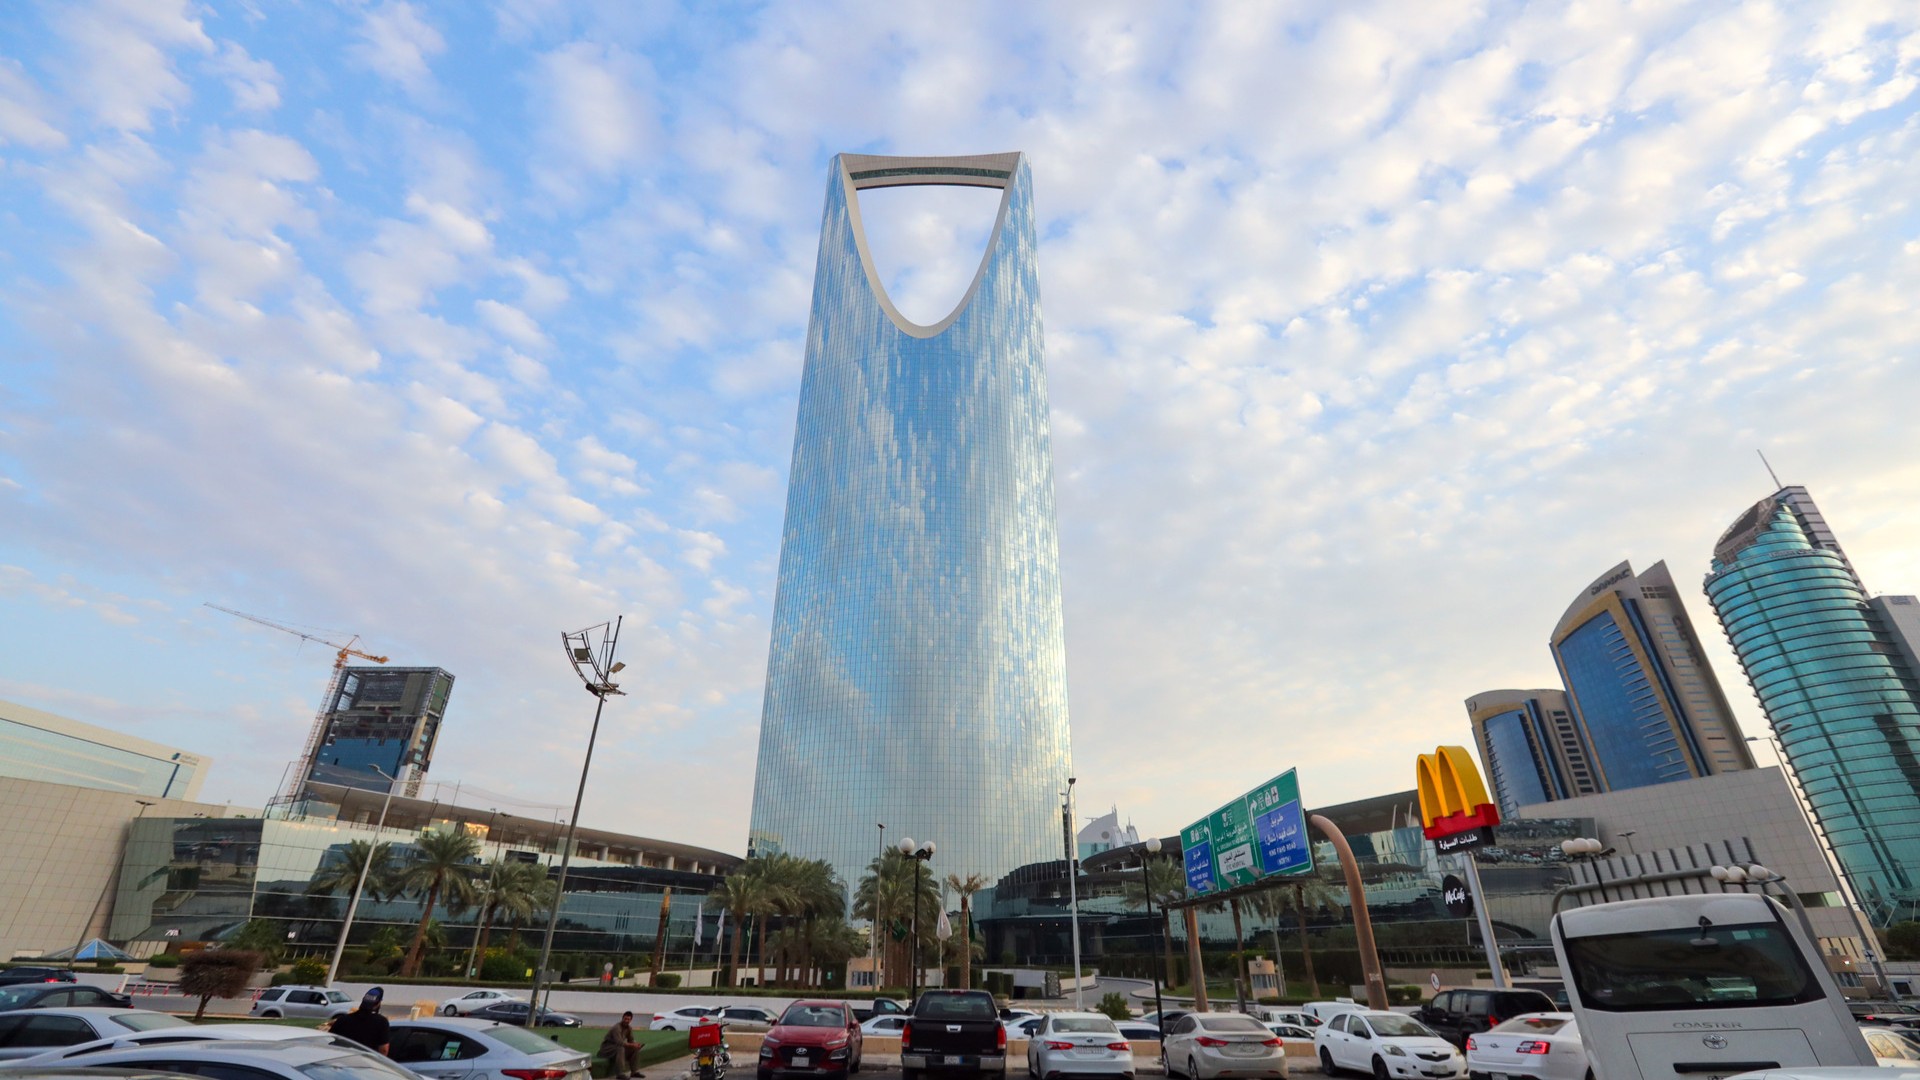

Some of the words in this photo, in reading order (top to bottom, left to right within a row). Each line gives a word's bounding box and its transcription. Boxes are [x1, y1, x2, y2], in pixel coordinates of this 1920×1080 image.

[1439, 838, 1458, 850] السيارة
[1460, 834, 1478, 846] طلبات
[1672, 1021, 1743, 1029] COASTER
